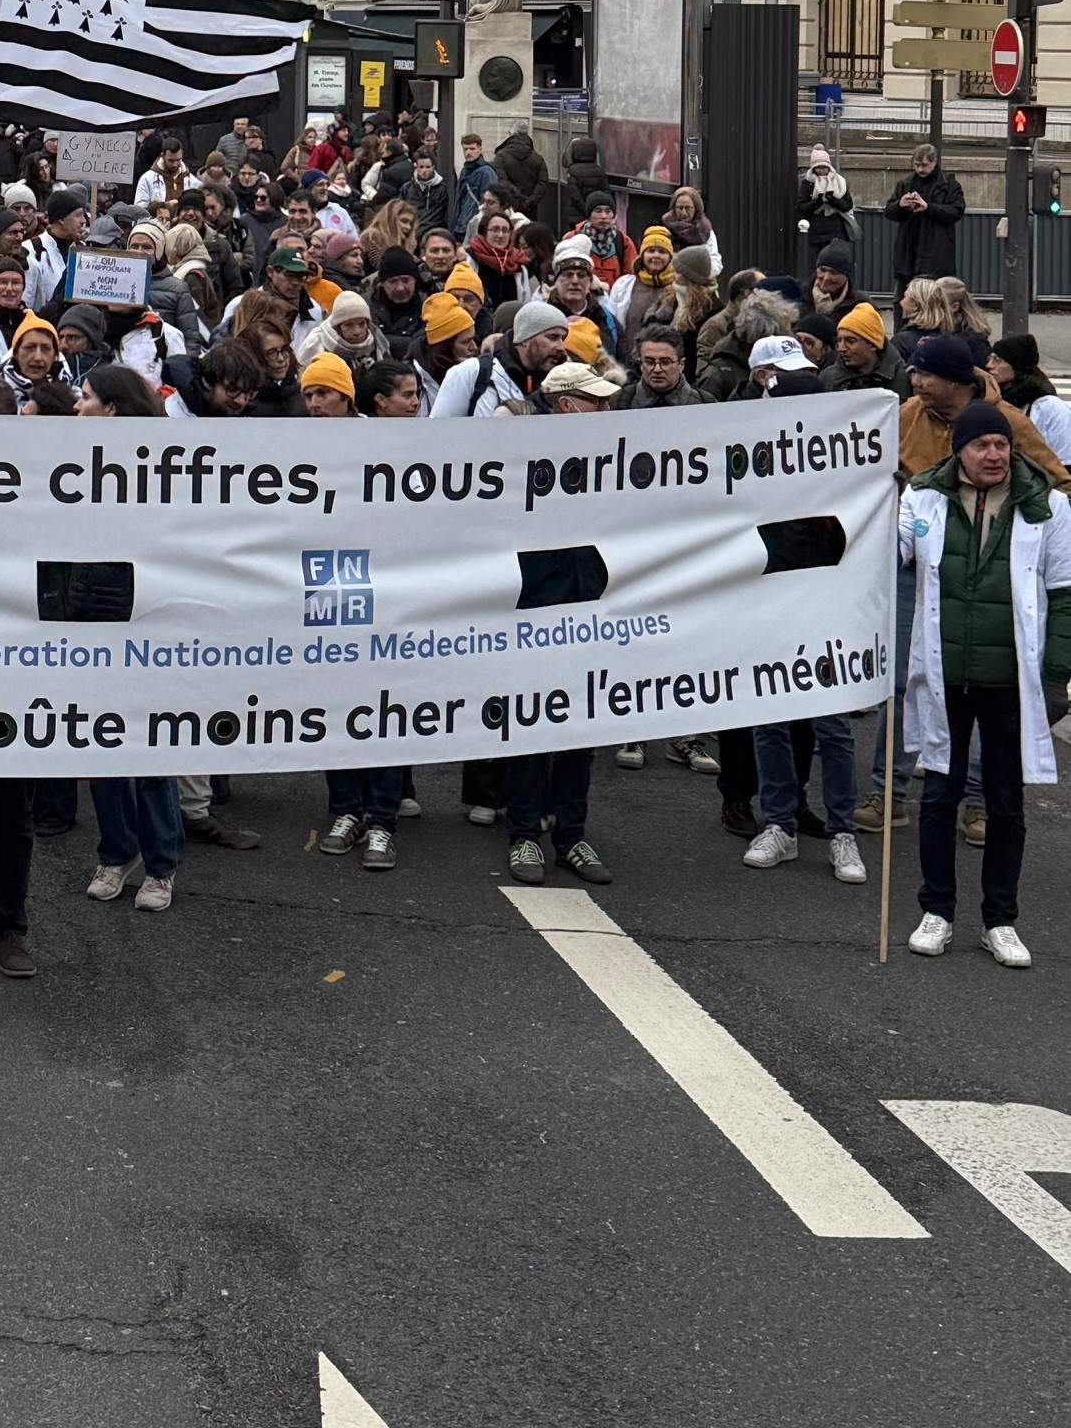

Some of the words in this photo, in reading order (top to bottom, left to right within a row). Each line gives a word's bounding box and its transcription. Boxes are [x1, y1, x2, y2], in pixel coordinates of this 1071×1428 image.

[49, 445, 336, 514] chiffres,
[363, 460, 505, 502] nous
[525, 437, 709, 512] parlons
[725, 421, 884, 495] patients
[124, 637, 292, 667] Nationale
[303, 636, 359, 664] des
[369, 625, 508, 662] Médecins
[516, 611, 671, 650] Radiologues
[148, 694, 327, 746] moins
[345, 690, 465, 738] cher
[481, 687, 570, 741] que
[587, 669, 739, 719] l'erreur
[752, 633, 888, 698] médicale
